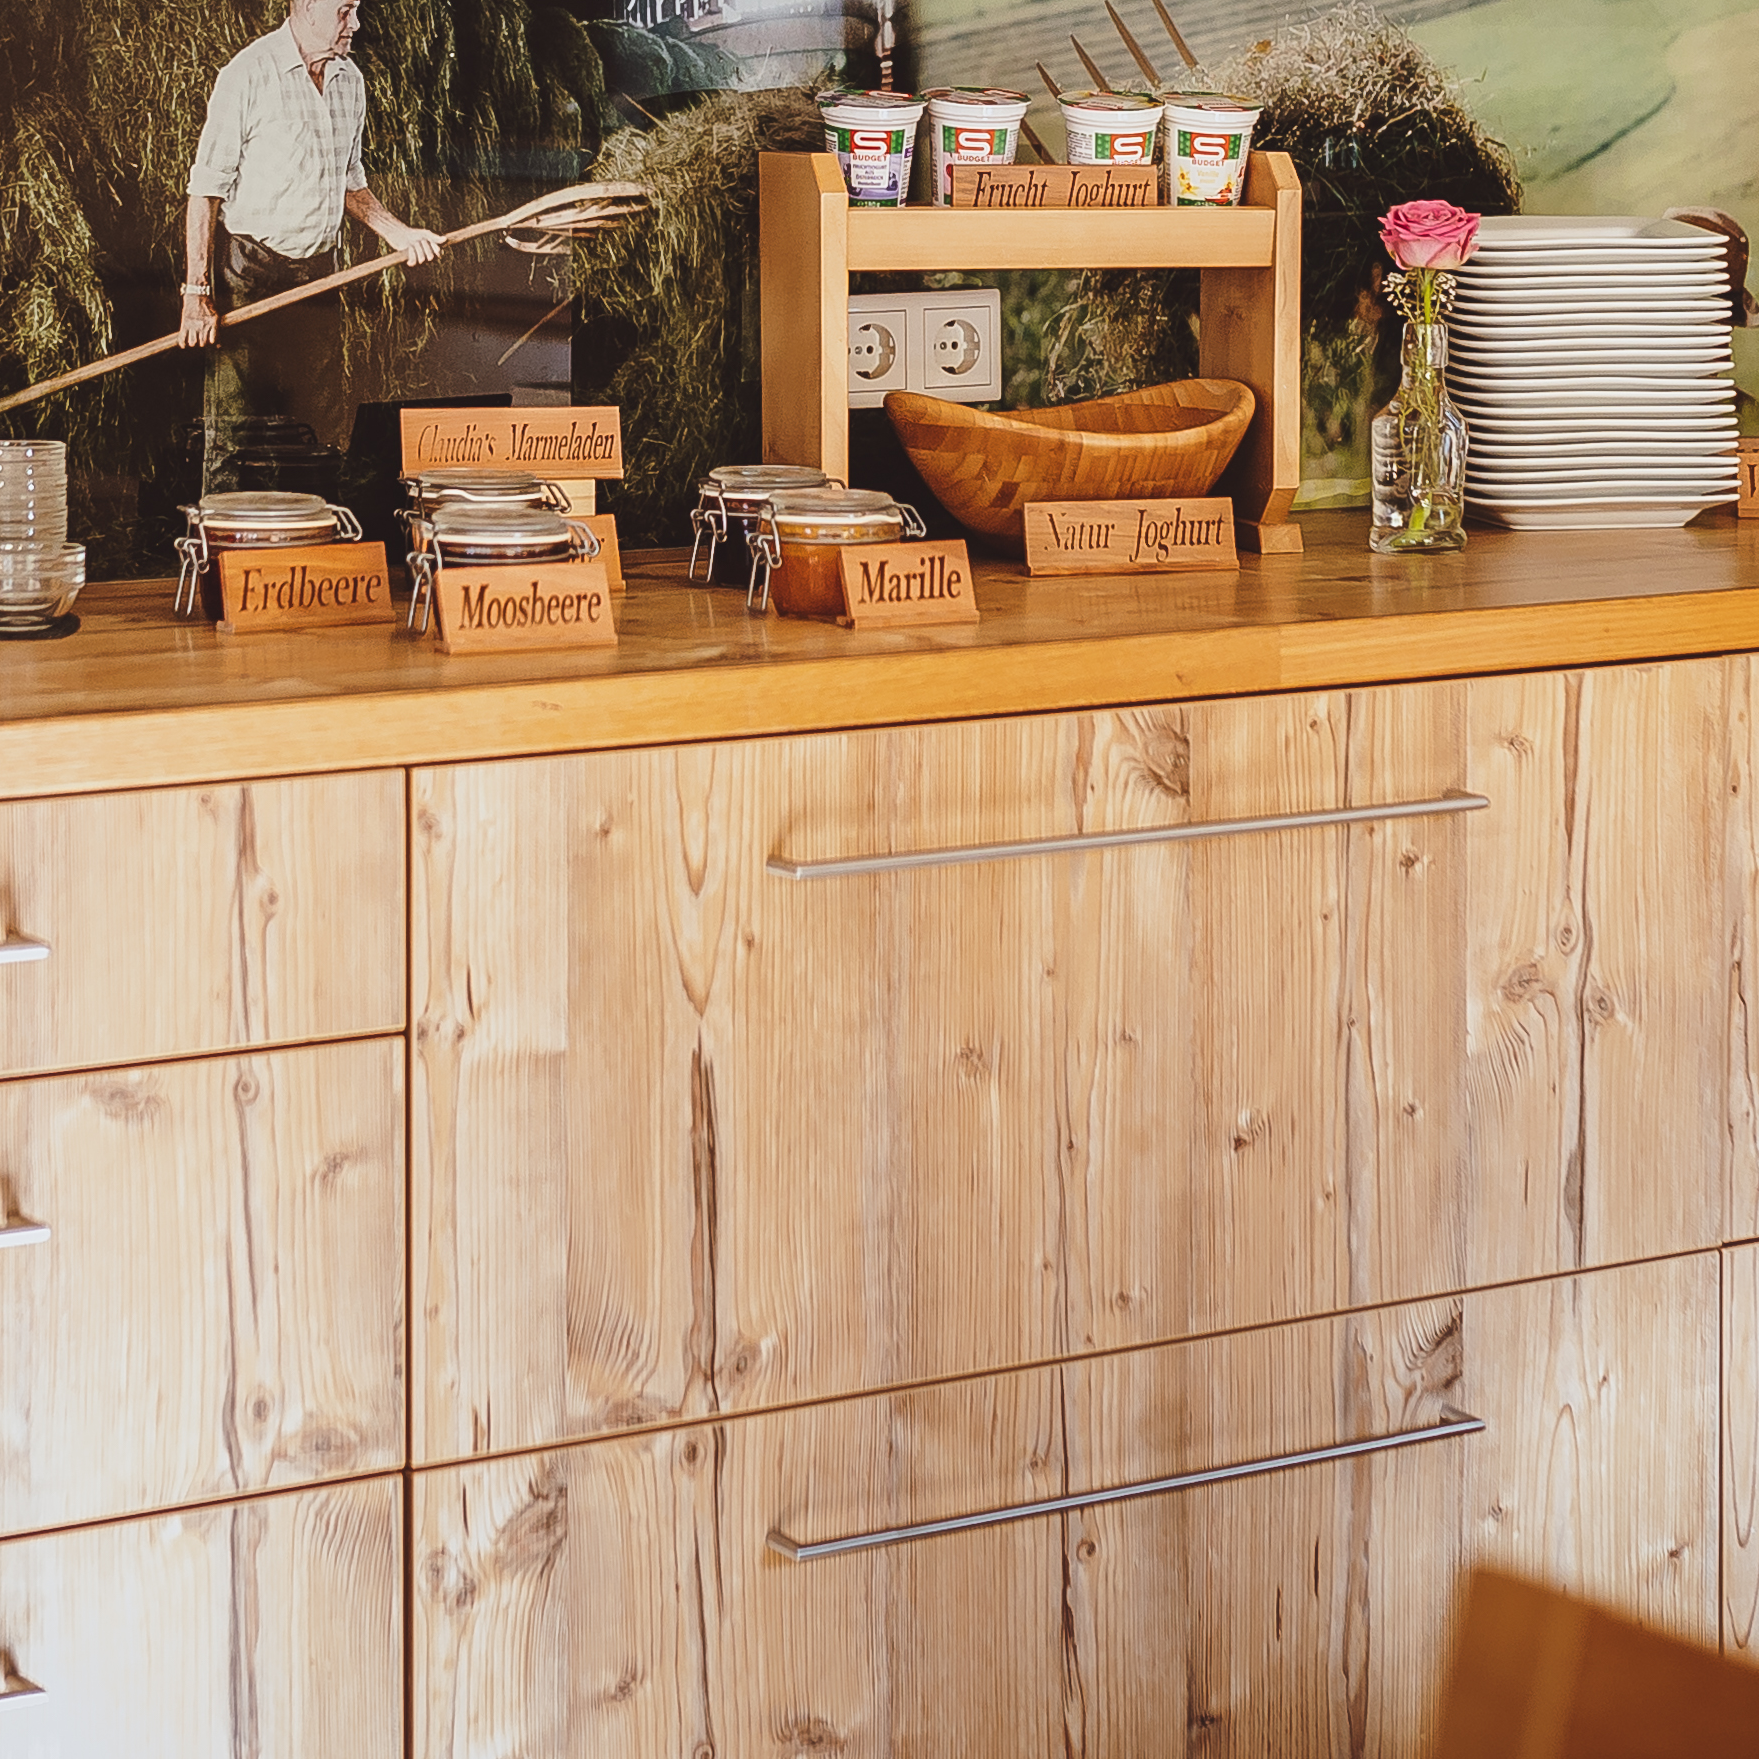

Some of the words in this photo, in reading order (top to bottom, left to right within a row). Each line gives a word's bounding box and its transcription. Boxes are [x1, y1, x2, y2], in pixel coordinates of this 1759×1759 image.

[852, 154, 888, 162] BUDGET
[957, 154, 992, 163] BUDGET
[1191, 159, 1226, 167] BUDGET
[972, 170, 1049, 208] Frucht
[417, 423, 496, 463] Claudia's
[505, 421, 615, 462] Marmeladen
[1044, 512, 1115, 551] Natur
[1128, 507, 1225, 563] Joghurt
[238, 565, 383, 614] Erdbeere
[857, 554, 962, 604] Marille
[457, 580, 602, 631] Moosbeere
